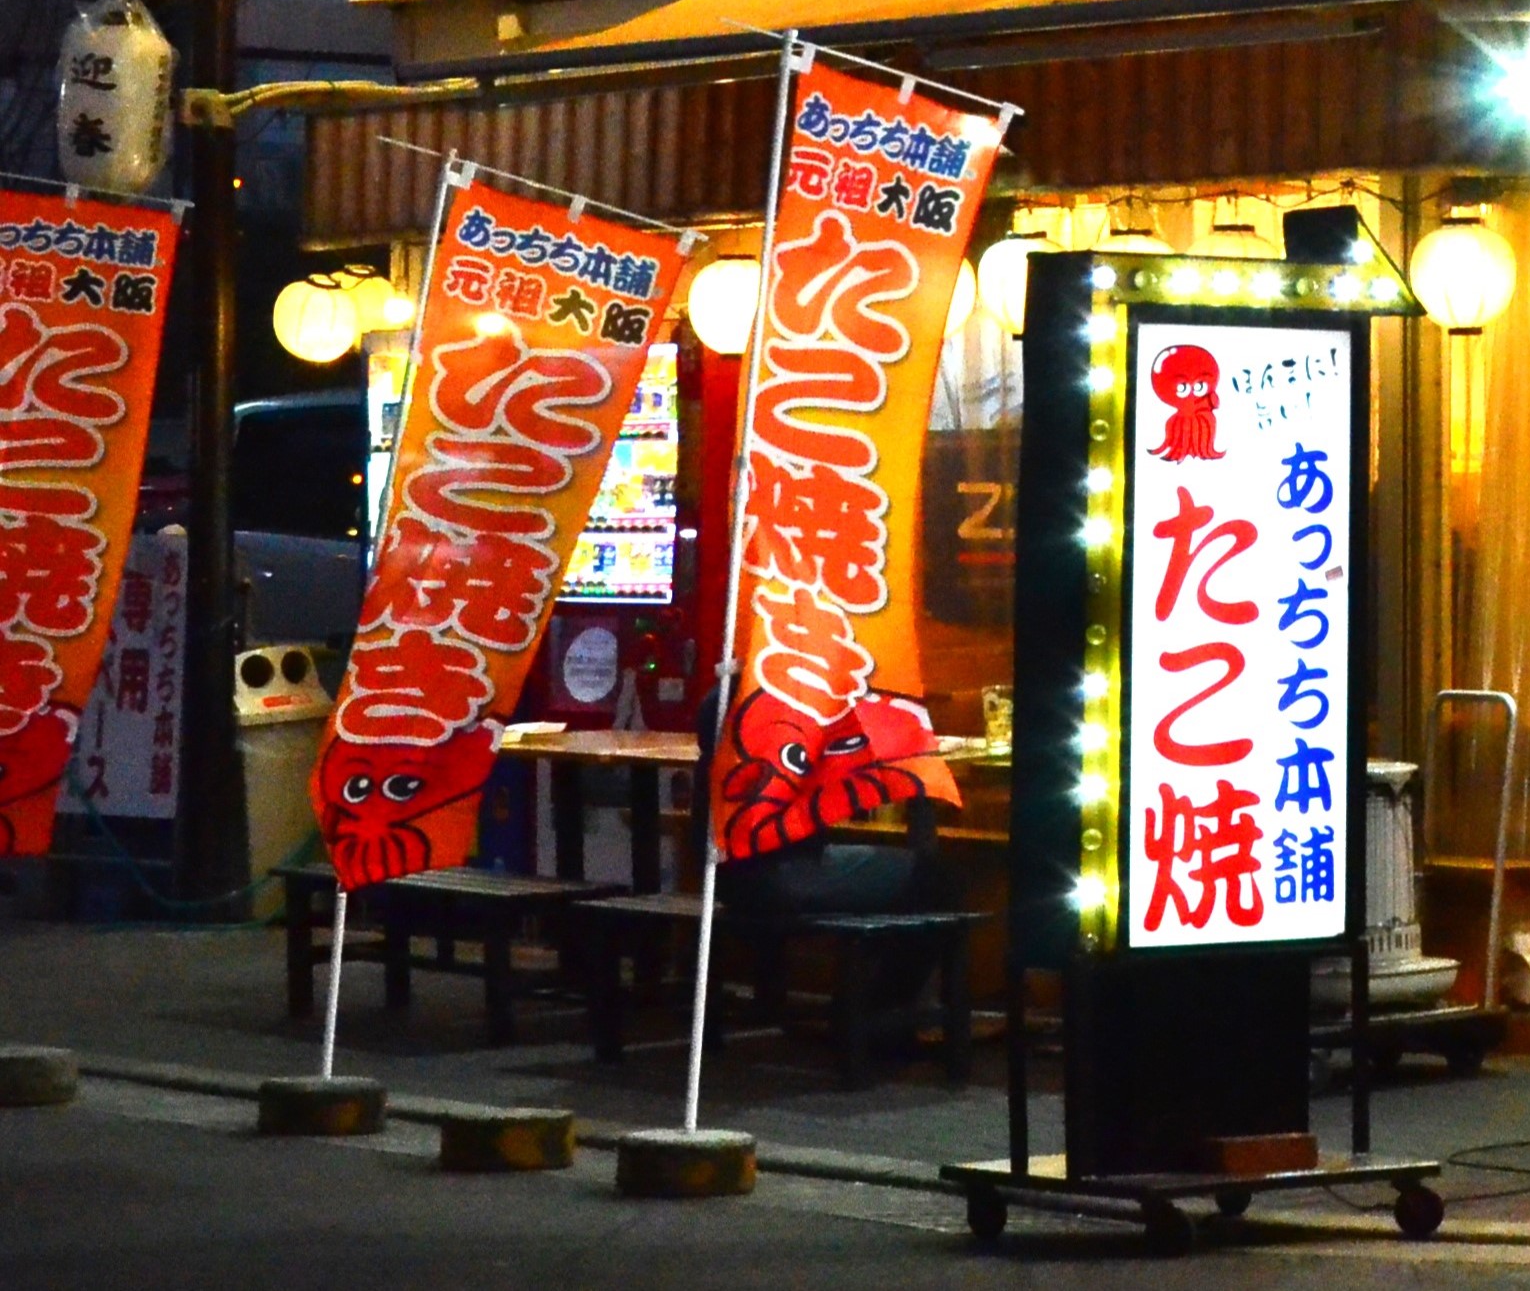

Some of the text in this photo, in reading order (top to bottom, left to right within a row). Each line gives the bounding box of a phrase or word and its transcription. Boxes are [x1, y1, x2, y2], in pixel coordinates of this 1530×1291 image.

[796, 92, 972, 179] あっちち本舗
[788, 150, 960, 233] 元祖 大阪
[0, 262, 156, 314] 祖 大阪
[455, 208, 658, 299] あっちち本舗
[444, 255, 653, 346] 元祖 大阪
[741, 207, 919, 726] たこ焼き
[336, 322, 613, 746] たこ焼き
[1142, 483, 1265, 933] たこ焼
[1272, 441, 1336, 905] あっちち本舗
